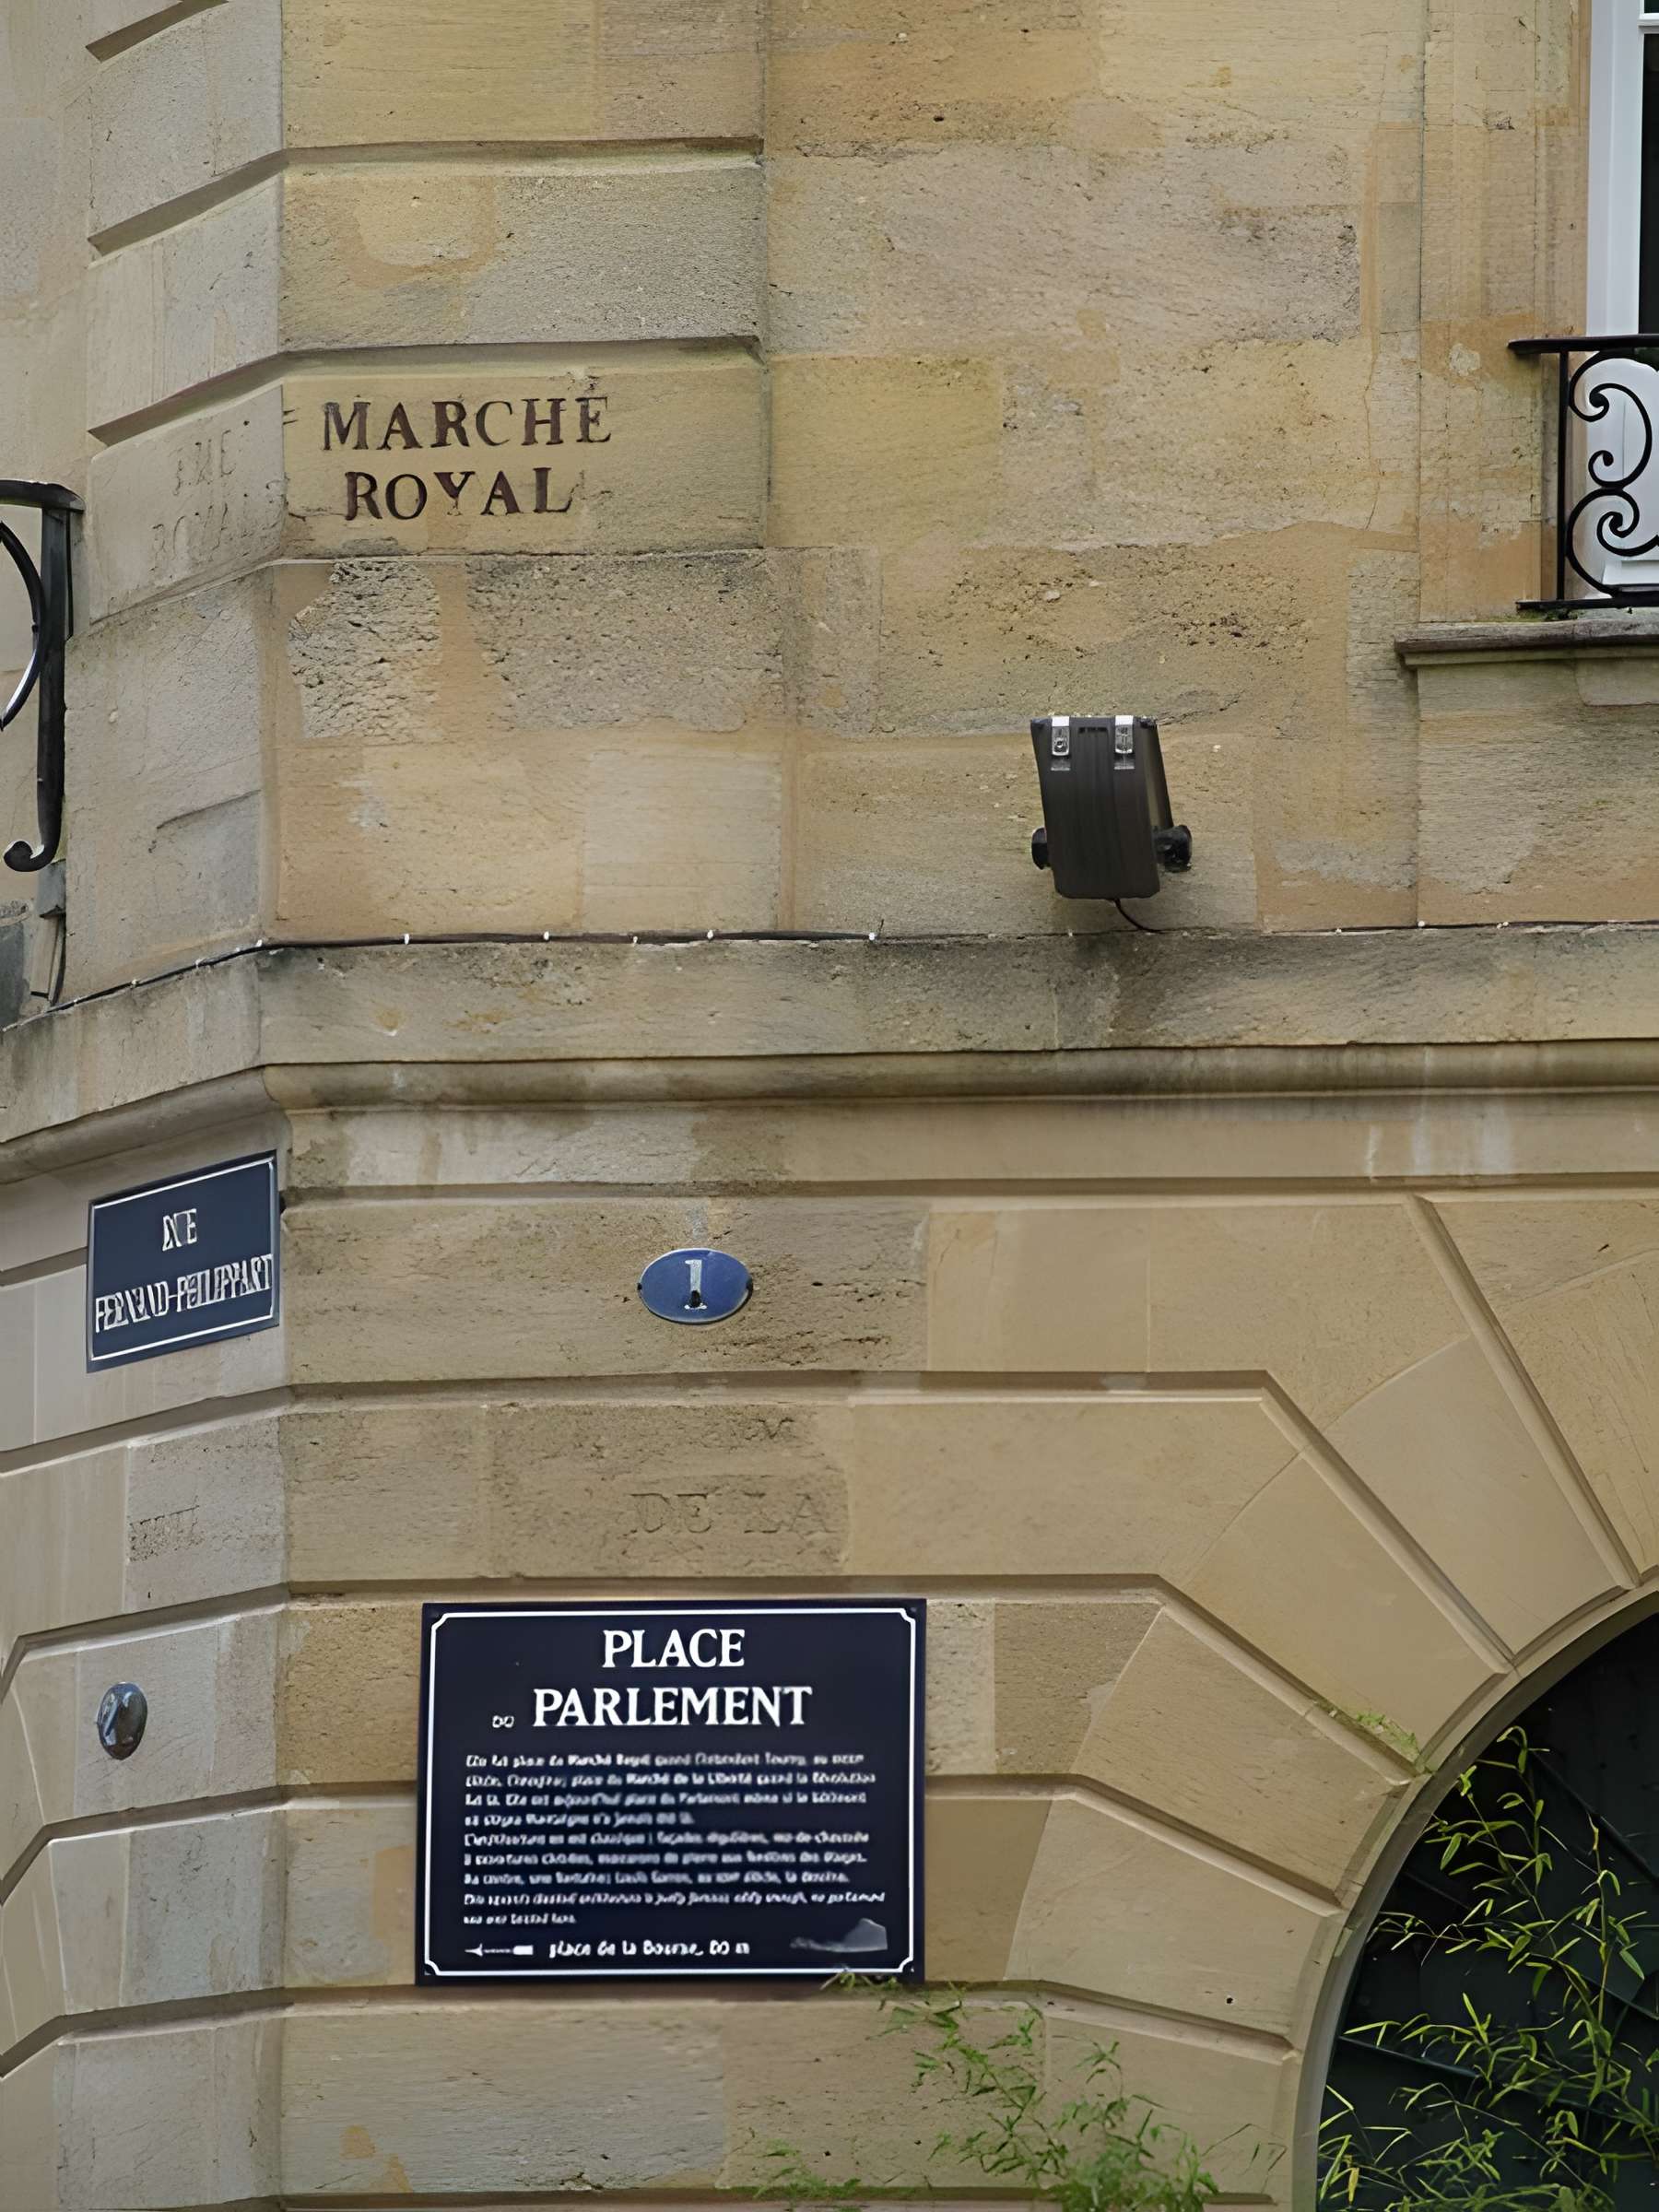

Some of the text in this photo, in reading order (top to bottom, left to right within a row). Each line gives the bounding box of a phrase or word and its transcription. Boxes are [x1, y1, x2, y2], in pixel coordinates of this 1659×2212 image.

[345, 466, 573, 521] ROYAL
[685, 1259, 708, 1310] 1
[602, 1629, 746, 1668] PLACE
[532, 1686, 813, 1727] PARLEMENT
